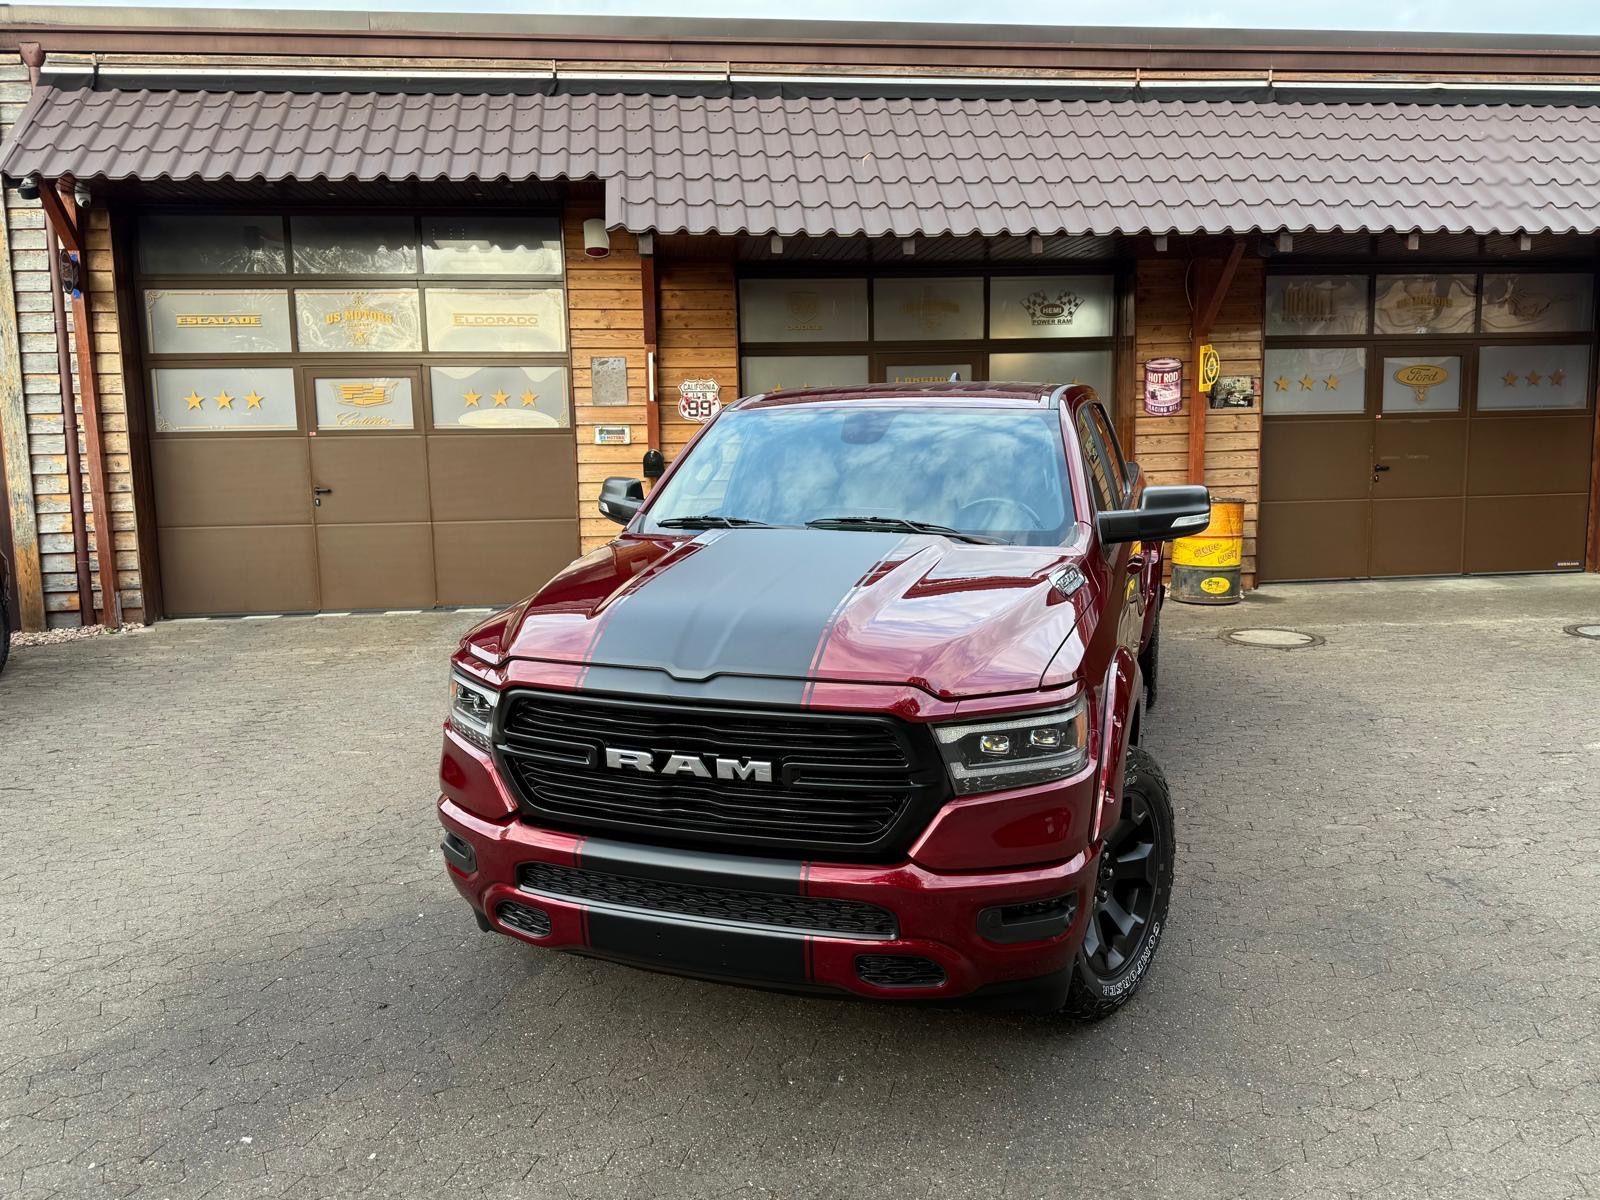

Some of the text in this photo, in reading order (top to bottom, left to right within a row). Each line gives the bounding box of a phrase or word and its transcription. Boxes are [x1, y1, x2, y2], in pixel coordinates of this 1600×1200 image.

[176, 315, 262, 326] ESCALADE
[325, 308, 394, 325] US MOTORS
[453, 315, 539, 326] ELDORADO
[1058, 318, 1073, 326] RAM
[1148, 371, 1179, 384] HOT ROD
[1406, 367, 1439, 382] Ford
[683, 383, 716, 391] CALIFORNIA
[688, 400, 712, 417] 99
[605, 747, 773, 783] RAM
